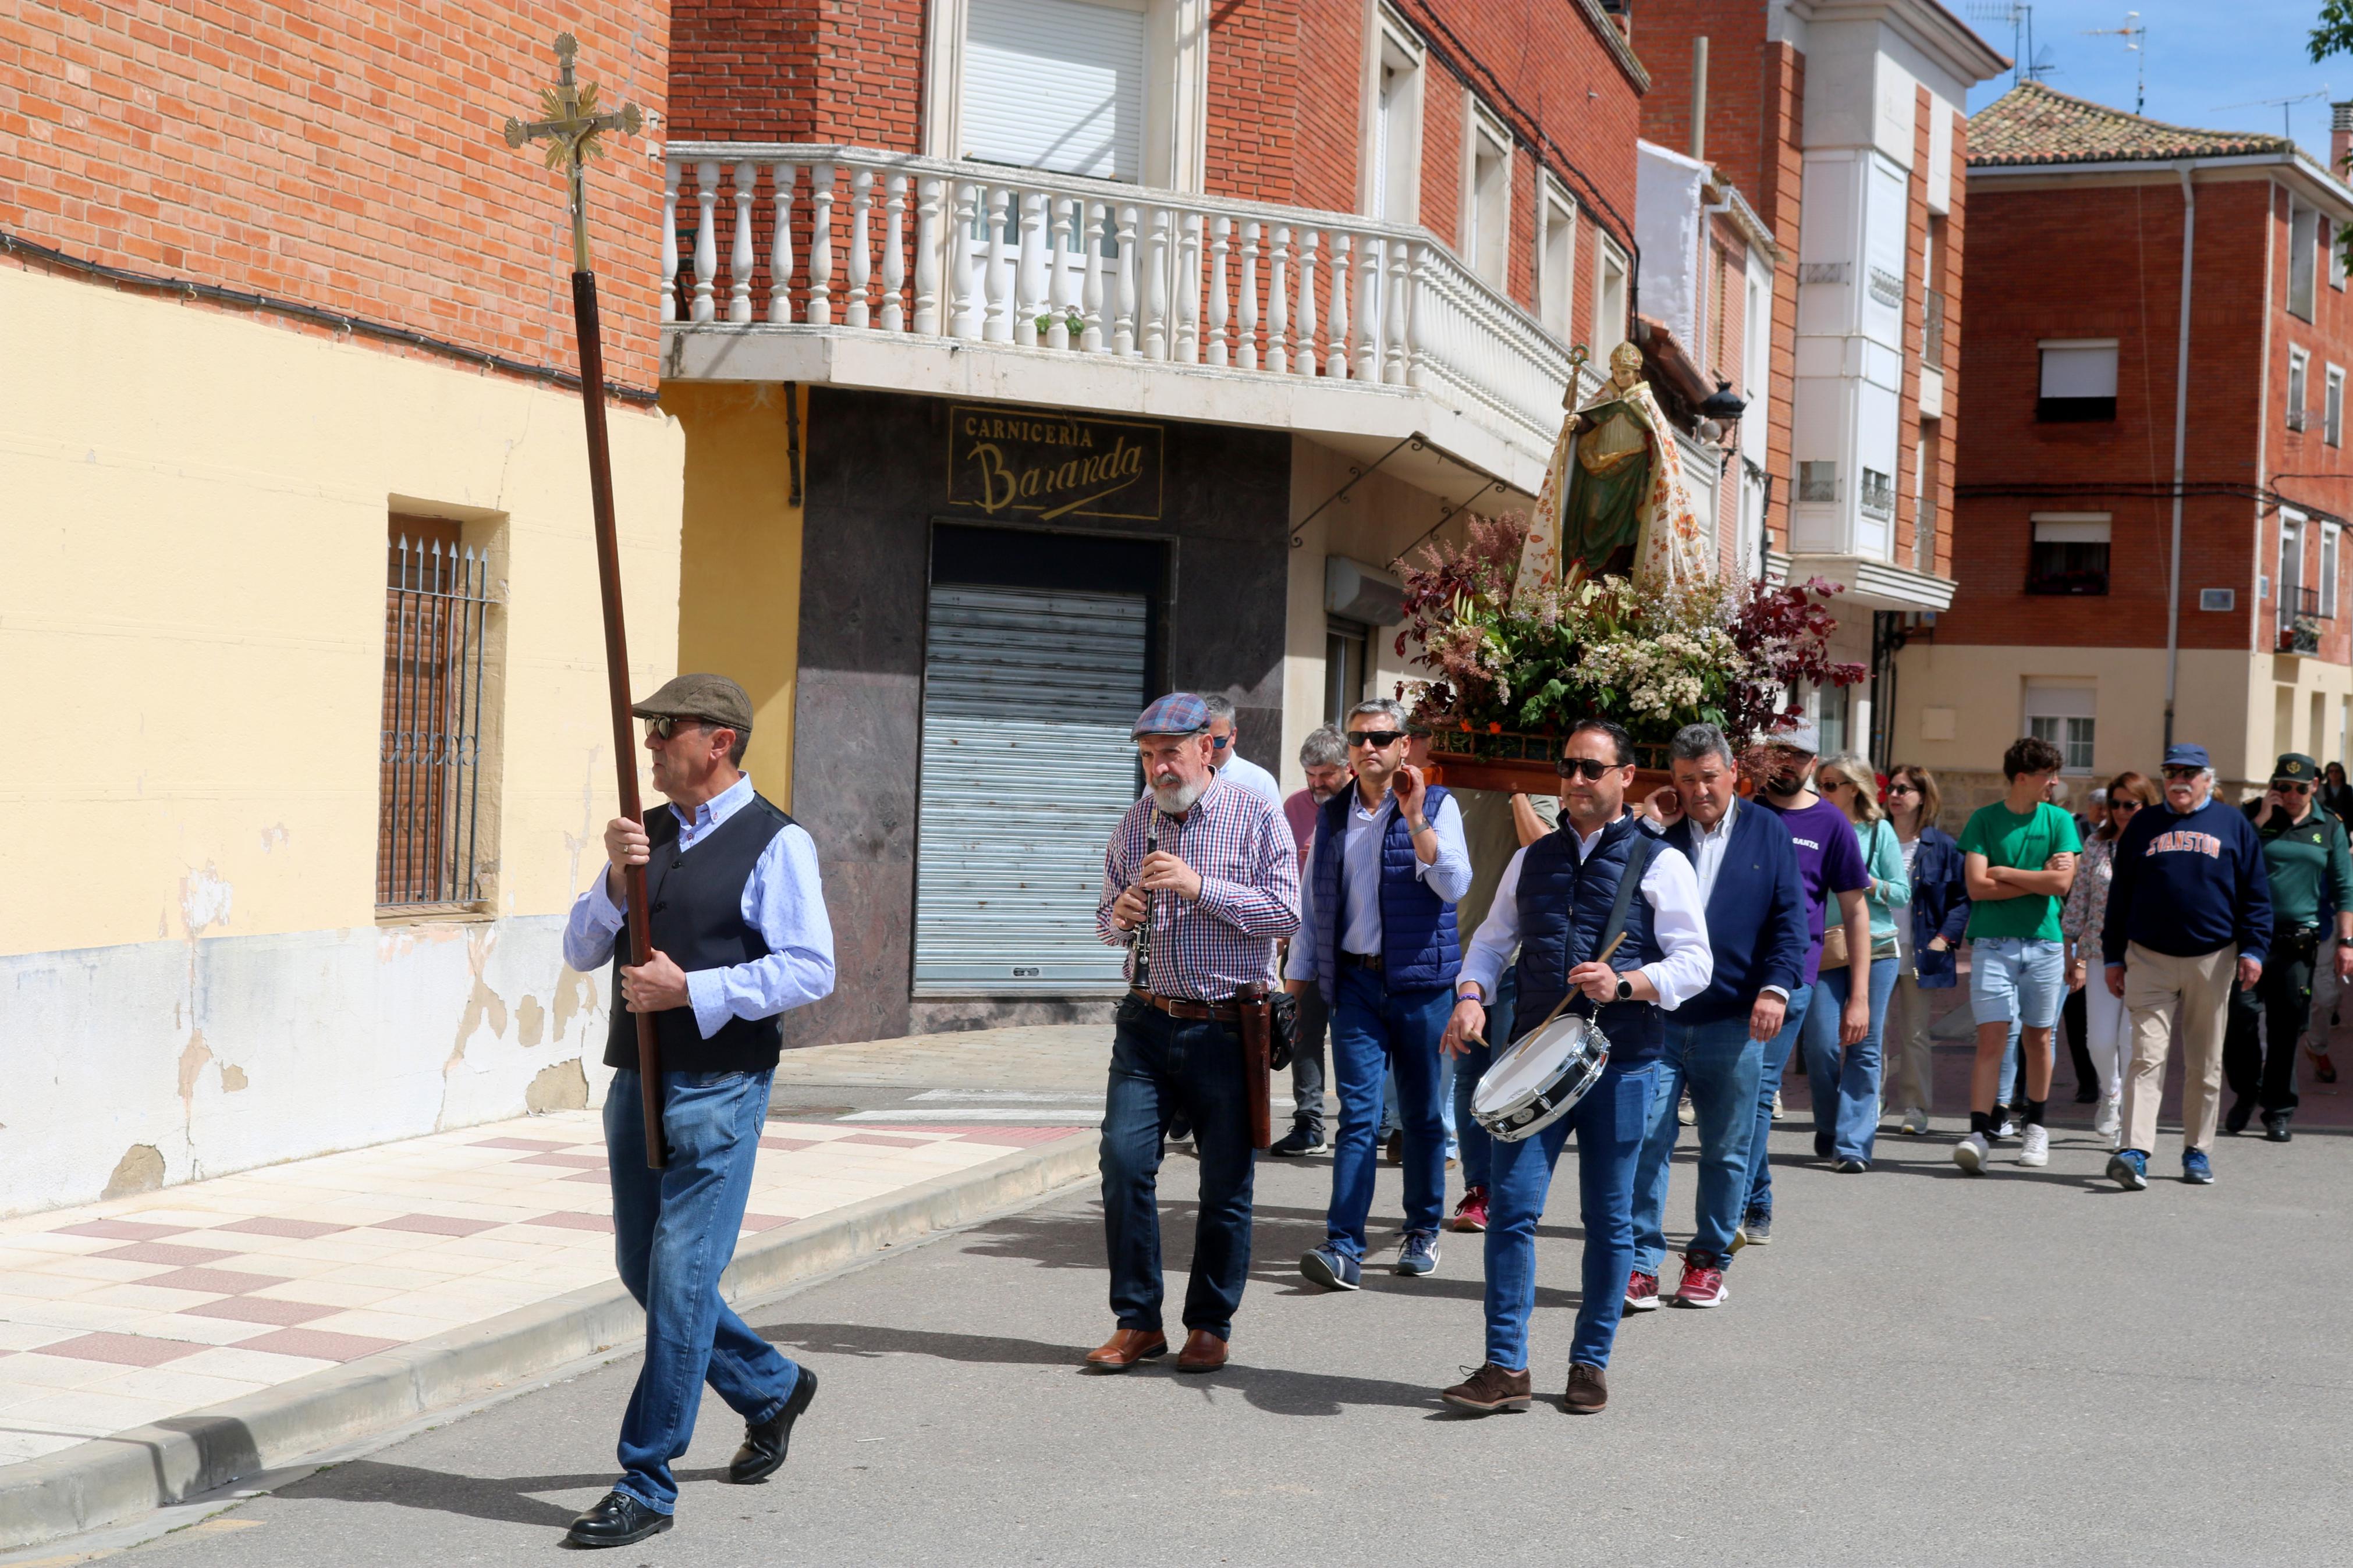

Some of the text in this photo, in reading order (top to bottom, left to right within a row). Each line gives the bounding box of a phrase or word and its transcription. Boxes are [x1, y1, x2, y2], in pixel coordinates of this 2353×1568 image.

[967, 436, 1142, 514] Baranda
[1793, 837, 1819, 850] SANTA
[2146, 831, 2220, 859] EVANSTON
